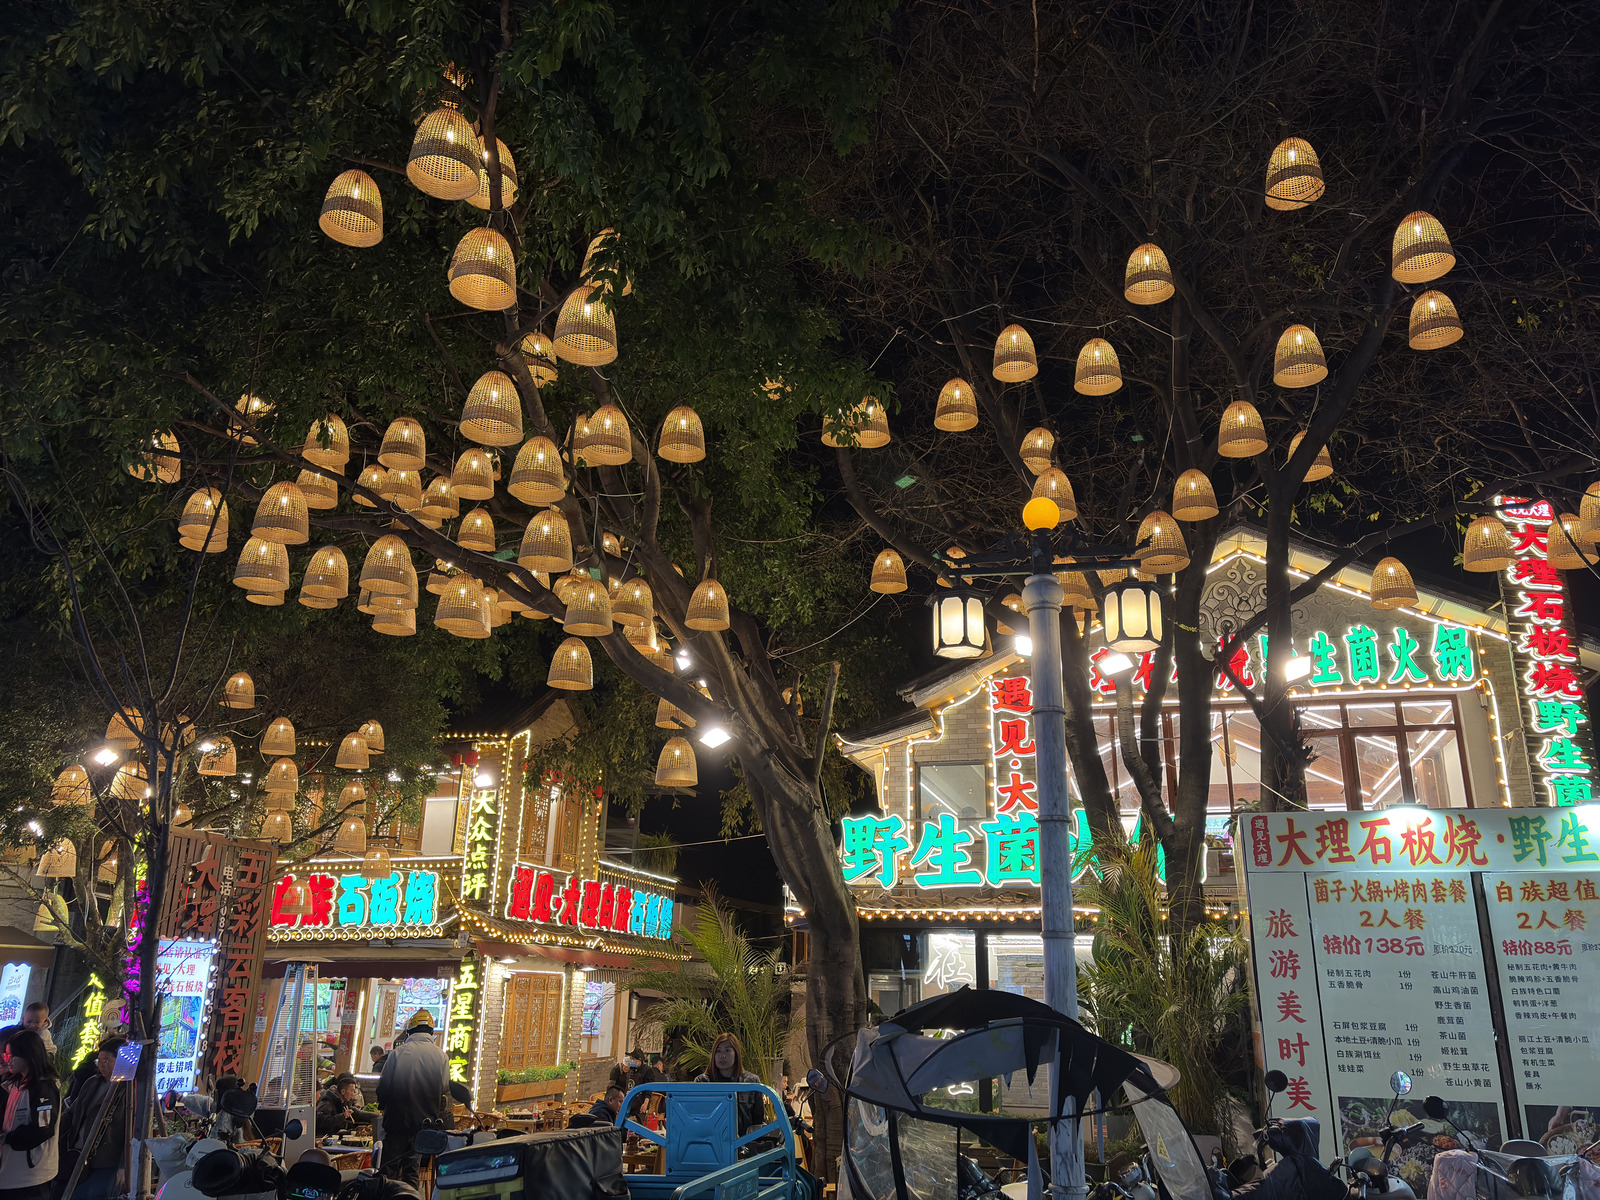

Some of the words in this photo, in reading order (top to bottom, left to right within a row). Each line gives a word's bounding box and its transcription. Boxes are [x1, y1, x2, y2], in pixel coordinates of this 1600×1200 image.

[464, 790, 497, 900] 大众点评
[1275, 811, 1600, 867] 大理石板烧·野生
[1313, 878, 1467, 904] 菌子火锅+烤肉套餐
[1495, 878, 1600, 903] 白族超值
[1359, 908, 1428, 930] 2人餐
[1516, 908, 1587, 931] 2人餐
[1323, 934, 1425, 957] 特价138元
[1502, 938, 1573, 956] 特价88元
[213, 851, 267, 1076] 五彩云客栈
[1327, 969, 1371, 978] 秘制五花肉
[1398, 970, 1411, 979] 1份
[1431, 971, 1477, 980] 苍山牛肝菌
[1328, 980, 1364, 989] 五香脆骨
[1399, 982, 1413, 991] 1份
[1264, 907, 1318, 1111] 旅游美时美
[1434, 1001, 1472, 1010] 野生香菌
[449, 965, 478, 1083] 五星商家
[1333, 1021, 1387, 1031] 石屏包浆豆腐
[1405, 1023, 1418, 1032] 1份
[1437, 1016, 1464, 1025] 鹿茸菌
[1334, 1035, 1403, 1046] 本地土豆+清脆小瓜
[1407, 1038, 1420, 1047] 1份
[1409, 1053, 1422, 1062] 1份
[1522, 1059, 1556, 1067] 有机生菜
[1337, 1064, 1365, 1074] 娃娃菜
[1411, 1068, 1424, 1077] 1份
[1442, 1062, 1490, 1072] 野生虫草花
[1445, 1077, 1492, 1088] 苍山小黄菌
